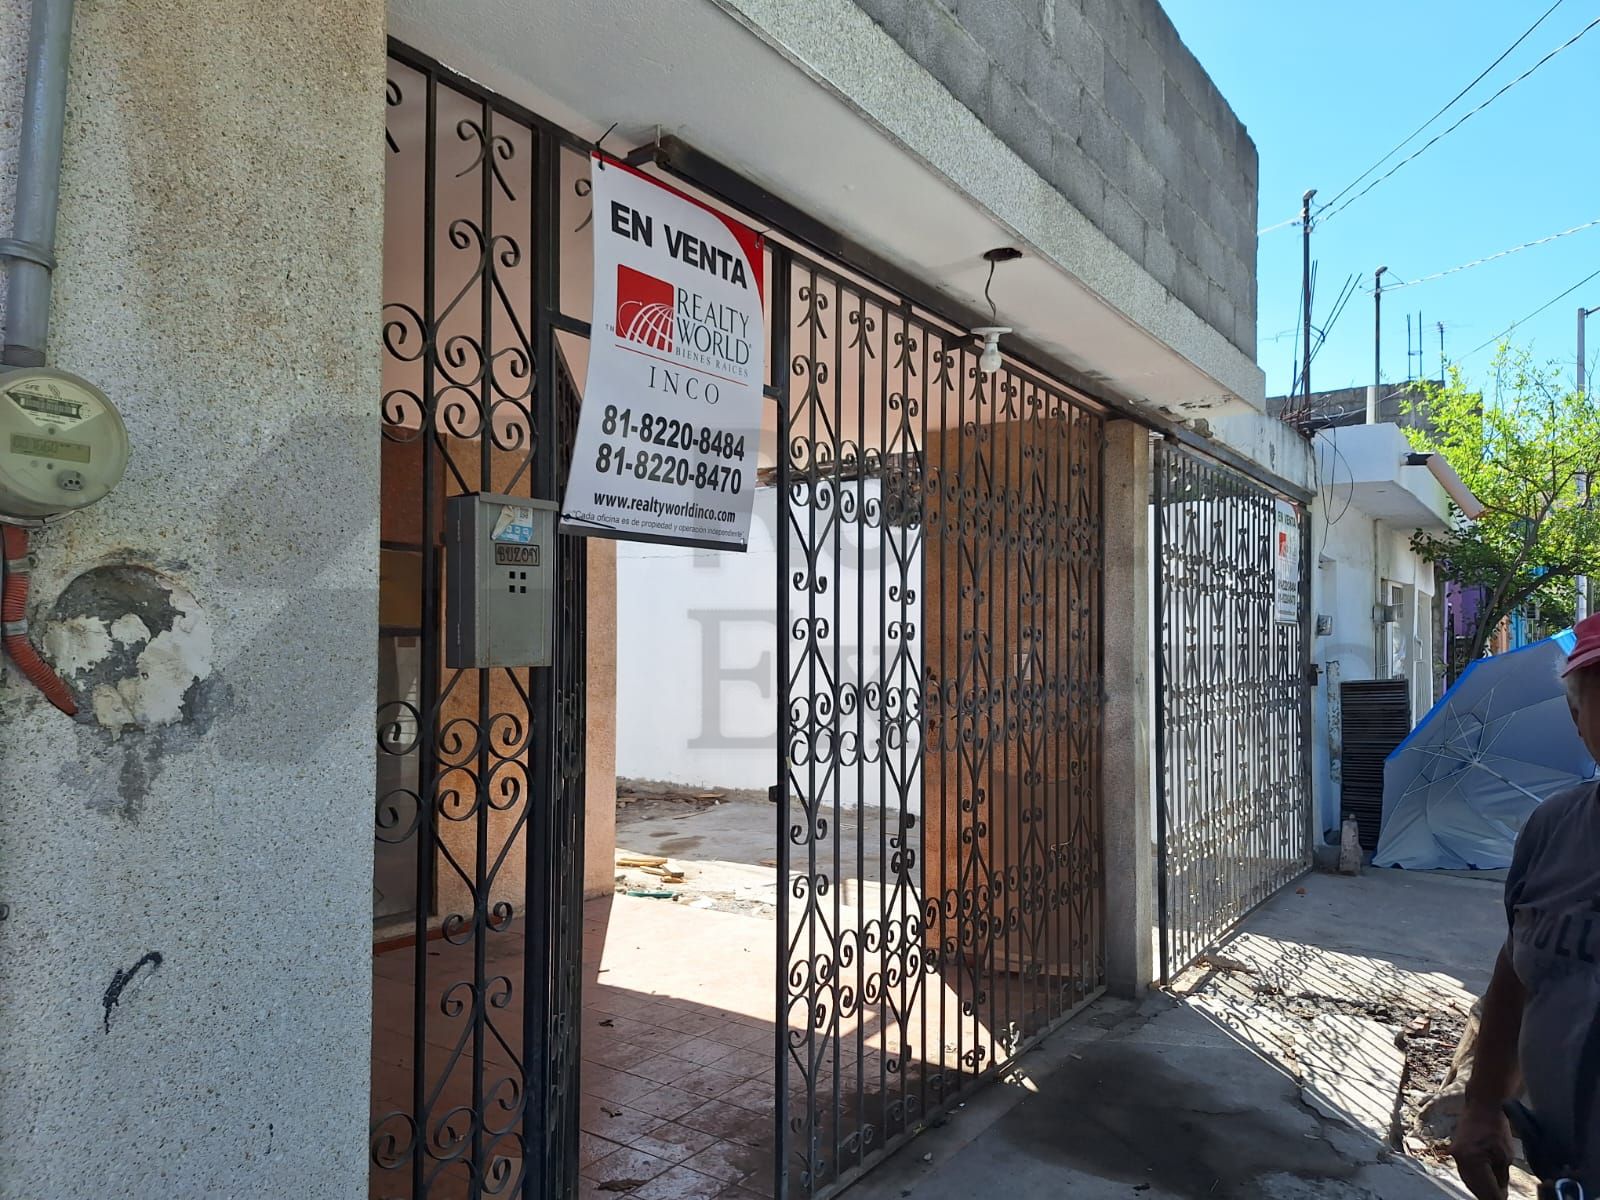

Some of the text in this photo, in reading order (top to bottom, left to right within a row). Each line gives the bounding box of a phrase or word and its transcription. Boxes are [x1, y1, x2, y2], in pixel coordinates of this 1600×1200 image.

[611, 200, 748, 290] EN VENTA
[677, 287, 750, 339] REALTY
[675, 345, 711, 367] BIENES
[648, 365, 720, 405] INCO
[601, 404, 746, 462] 81-8220-8484
[595, 443, 742, 494] 81-8220-8470
[593, 492, 736, 523] www.realtyworldinco.com
[631, 518, 641, 526] de
[641, 519, 673, 530] propiedad
